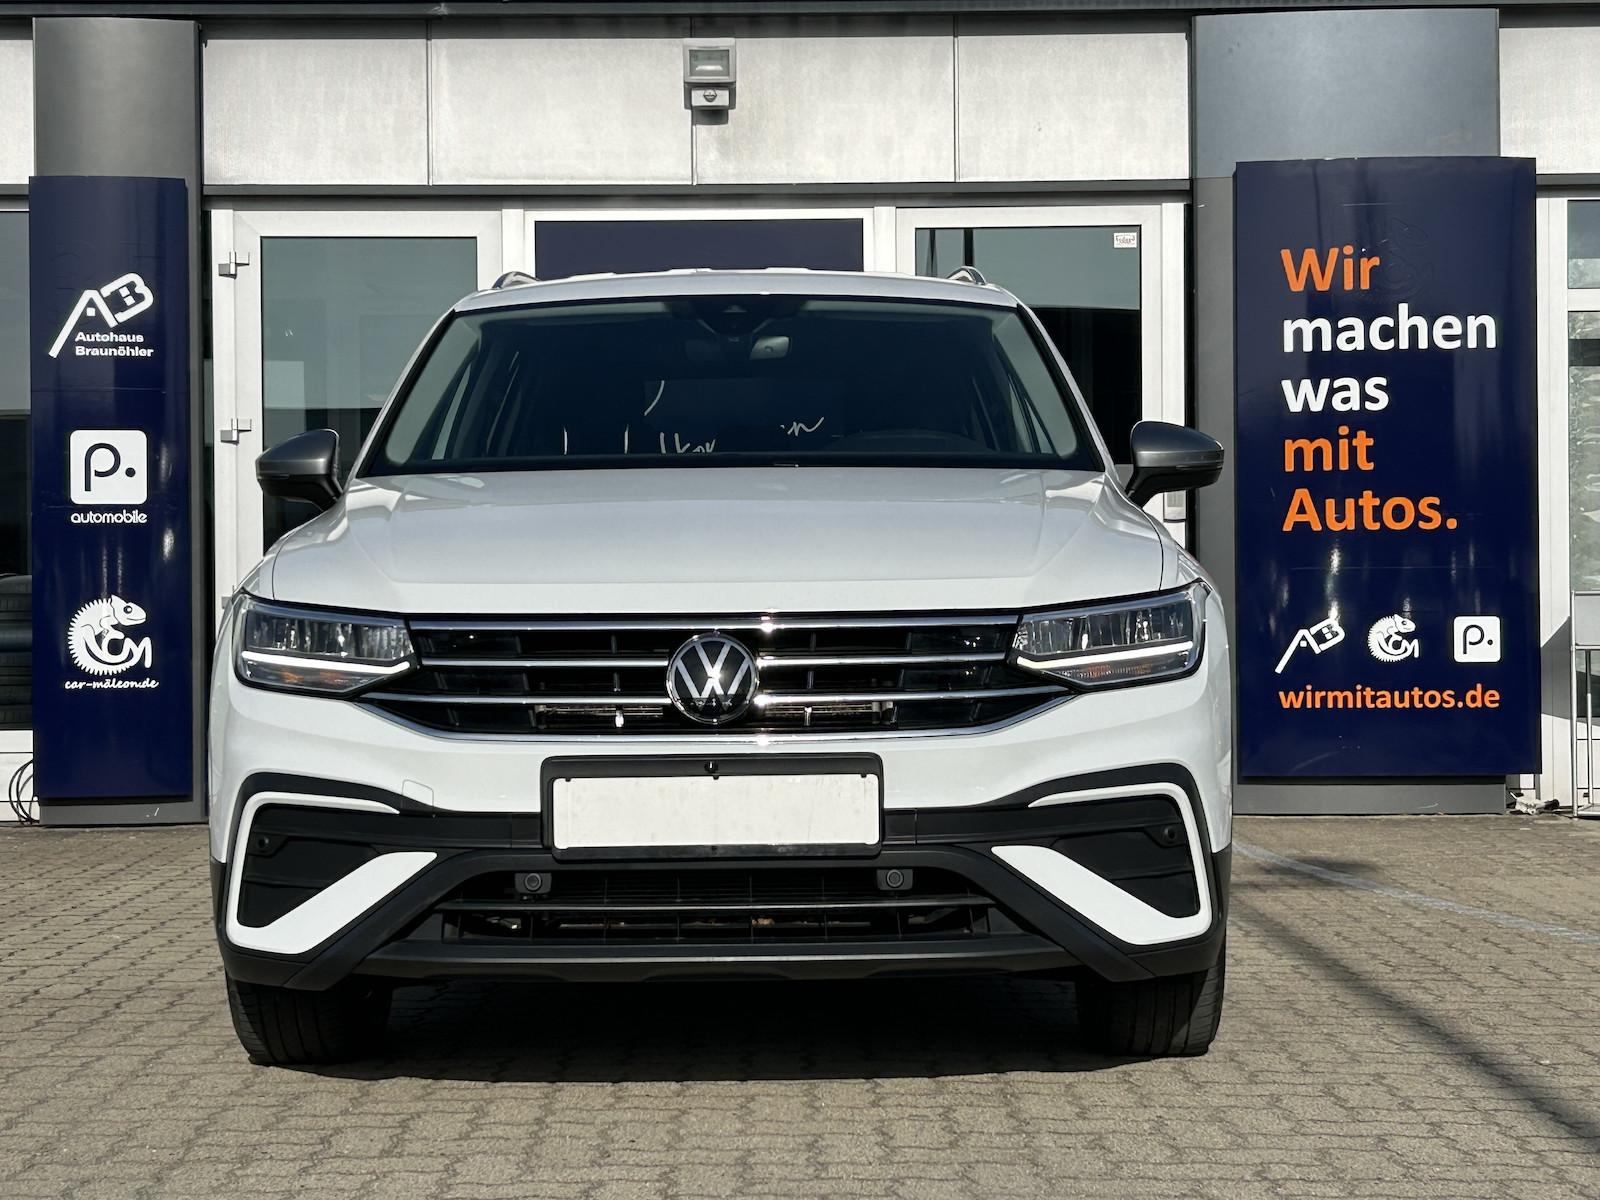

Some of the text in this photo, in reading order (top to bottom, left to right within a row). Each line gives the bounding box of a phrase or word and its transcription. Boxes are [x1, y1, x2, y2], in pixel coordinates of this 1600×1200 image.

[1281, 245, 1380, 291] Wir
[75, 331, 144, 342] Autohaus
[1283, 303, 1497, 352] machen
[75, 345, 154, 356] Braunöhler
[1281, 376, 1389, 412] was
[1284, 425, 1375, 472] mit
[70, 510, 148, 524] automobile
[1282, 488, 1458, 532] Autos.
[671, 636, 755, 718] VW
[1278, 683, 1500, 709] wirmitautos.de
